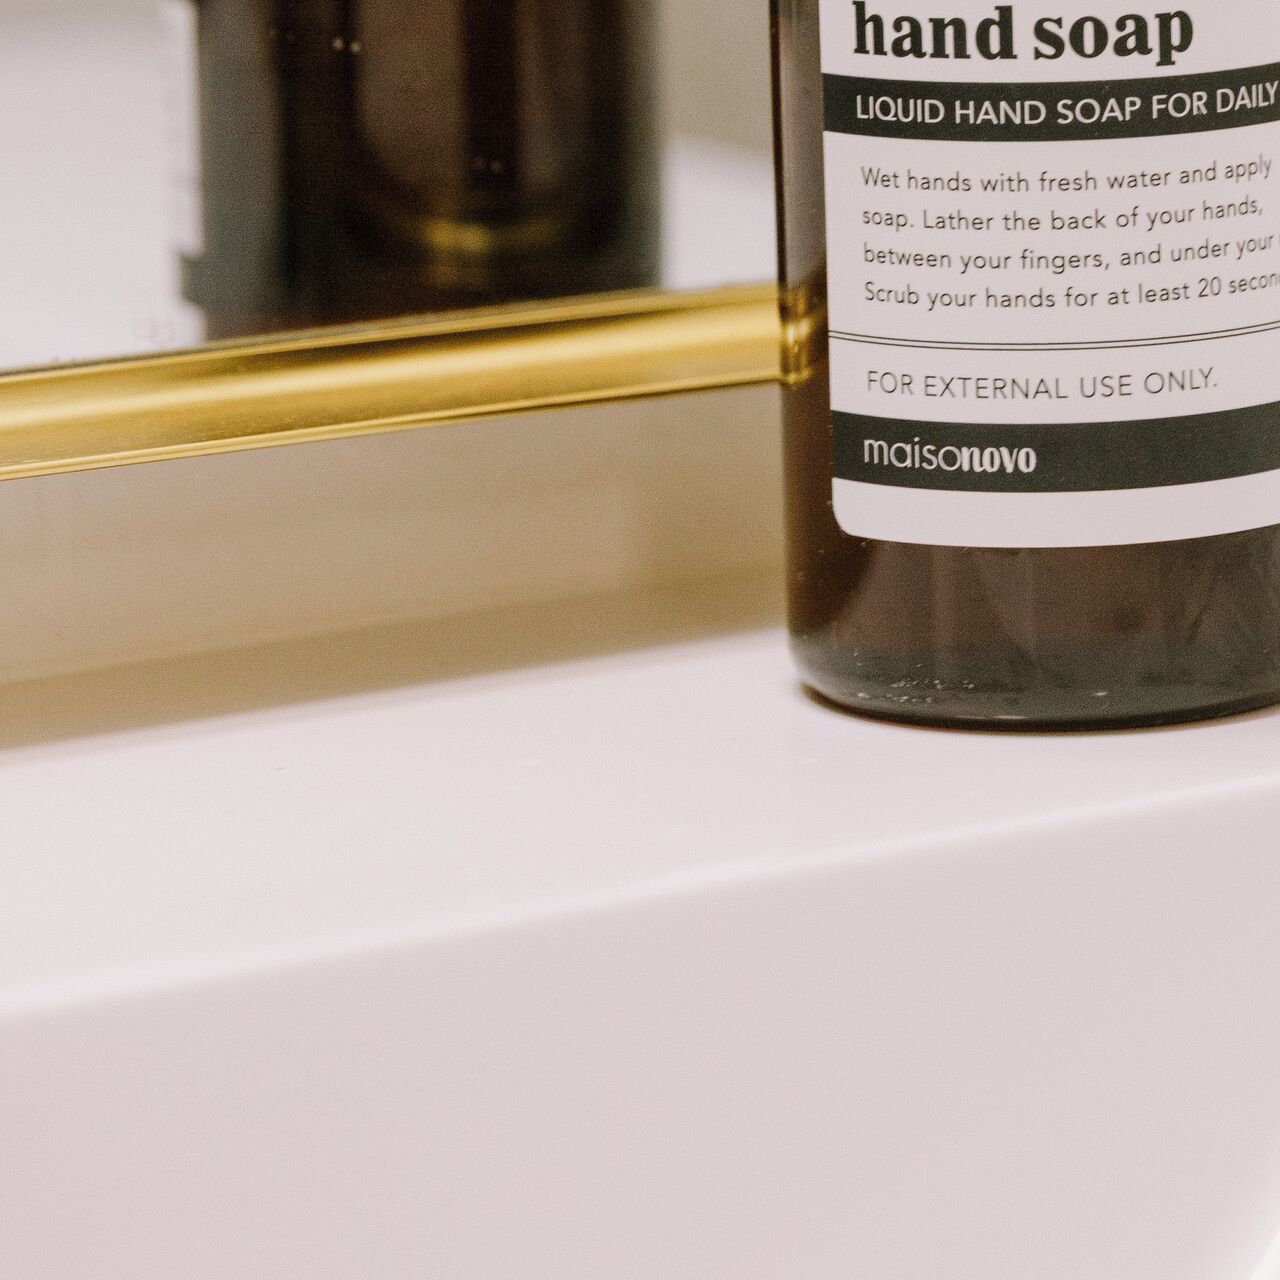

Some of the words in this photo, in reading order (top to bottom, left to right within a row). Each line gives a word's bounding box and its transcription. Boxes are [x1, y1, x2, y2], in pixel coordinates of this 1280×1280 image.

[852, 0, 1017, 60] hand
[1033, 8, 1194, 67] soap
[856, 93, 945, 124] LIQUID
[955, 99, 1046, 125] HAND
[1057, 96, 1141, 124] SOAP
[1152, 91, 1207, 120] FOR
[1216, 79, 1279, 114] DAILY
[861, 165, 900, 189] Wet
[907, 169, 971, 192] hands
[980, 171, 1030, 192] with
[1039, 169, 1098, 193] fresh
[1106, 169, 1171, 190] water
[1179, 160, 1217, 184] and
[1224, 154, 1272, 181] apply
[862, 207, 915, 233] soap.
[922, 210, 993, 231] Lather
[1003, 210, 1041, 231] the
[1050, 208, 1106, 231] back
[1116, 205, 1139, 228] of
[1146, 206, 1195, 231] your
[1202, 194, 1263, 220] hands,
[864, 242, 952, 269] between
[959, 251, 1012, 275] your
[1020, 249, 1111, 275] fingers,
[1120, 246, 1162, 267] and
[1170, 242, 1229, 265] under
[1236, 235, 1274, 258] your
[864, 281, 920, 305] Scrub
[926, 289, 976, 311] your
[985, 287, 1056, 309] hands
[1065, 286, 1098, 307] for
[1108, 285, 1129, 305] at
[1139, 282, 1190, 304] least
[1197, 277, 1221, 299] 20
[866, 370, 915, 396] FOR
[924, 376, 1068, 400] EXTERNAL
[1080, 374, 1133, 398] USE
[1143, 366, 1218, 393] ONLY.
[863, 437, 1037, 473] maisonovo
